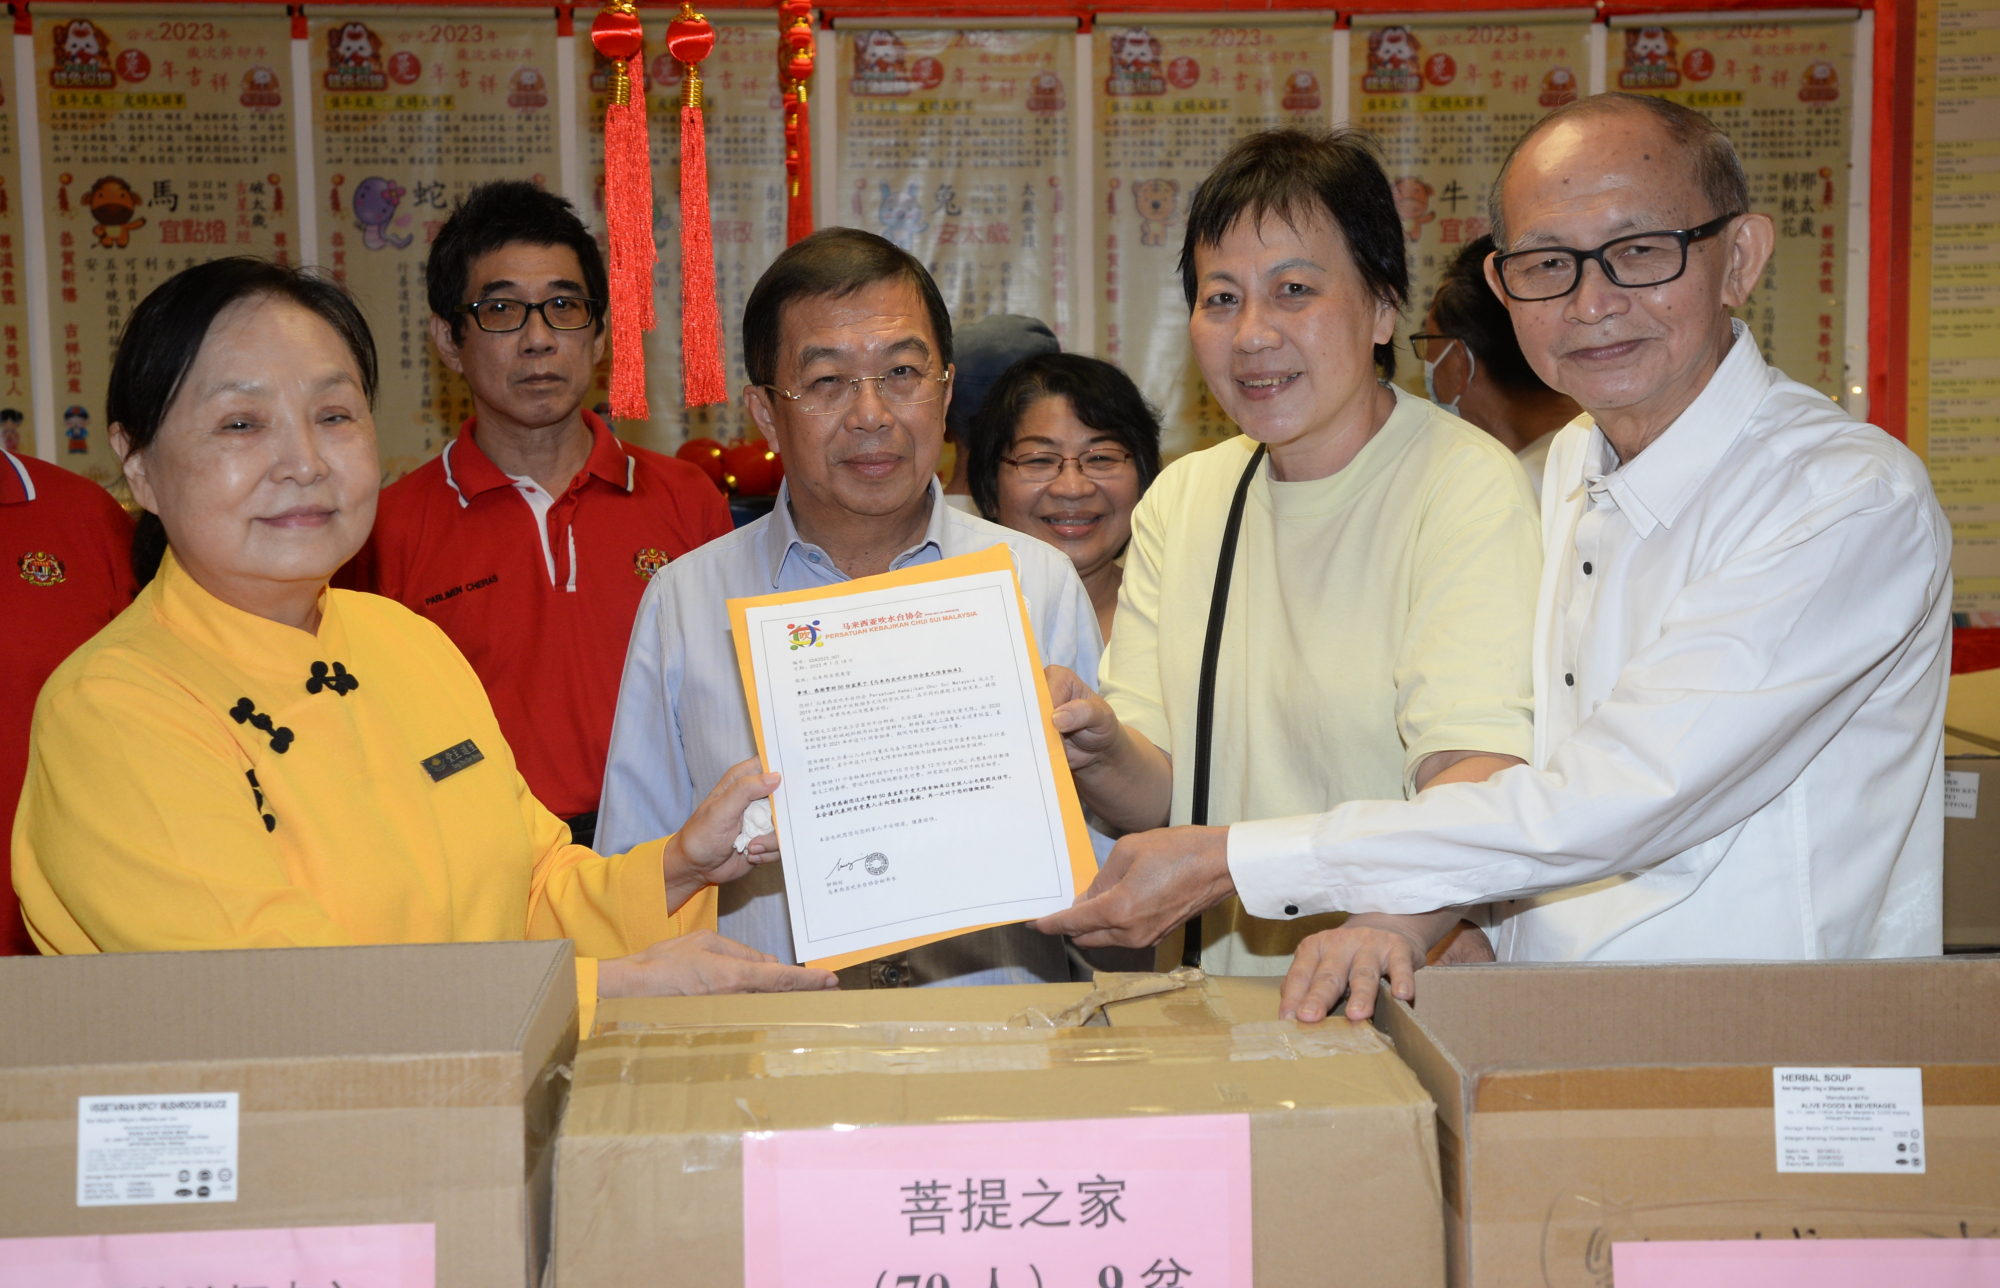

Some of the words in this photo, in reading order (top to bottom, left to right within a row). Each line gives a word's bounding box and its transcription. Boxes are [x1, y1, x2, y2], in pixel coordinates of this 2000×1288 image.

[148, 179, 178, 212] 馬
[413, 180, 447, 209] 蛇
[1440, 180, 1468, 212] 牛
[466, 574, 498, 592] CHERAS
[825, 628, 868, 640] PERSATUAN
[869, 621, 909, 633] KEBAJIKAN
[911, 617, 928, 627] CHUI
[928, 615, 941, 624] SUI
[942, 611, 978, 623] MALAYSIA
[1781, 1074, 1821, 1082] HERBAL
[1824, 1074, 1851, 1082] SOUP
[203, 1100, 227, 1109] SAUCE
[899, 1174, 1128, 1236] 菩提之家
